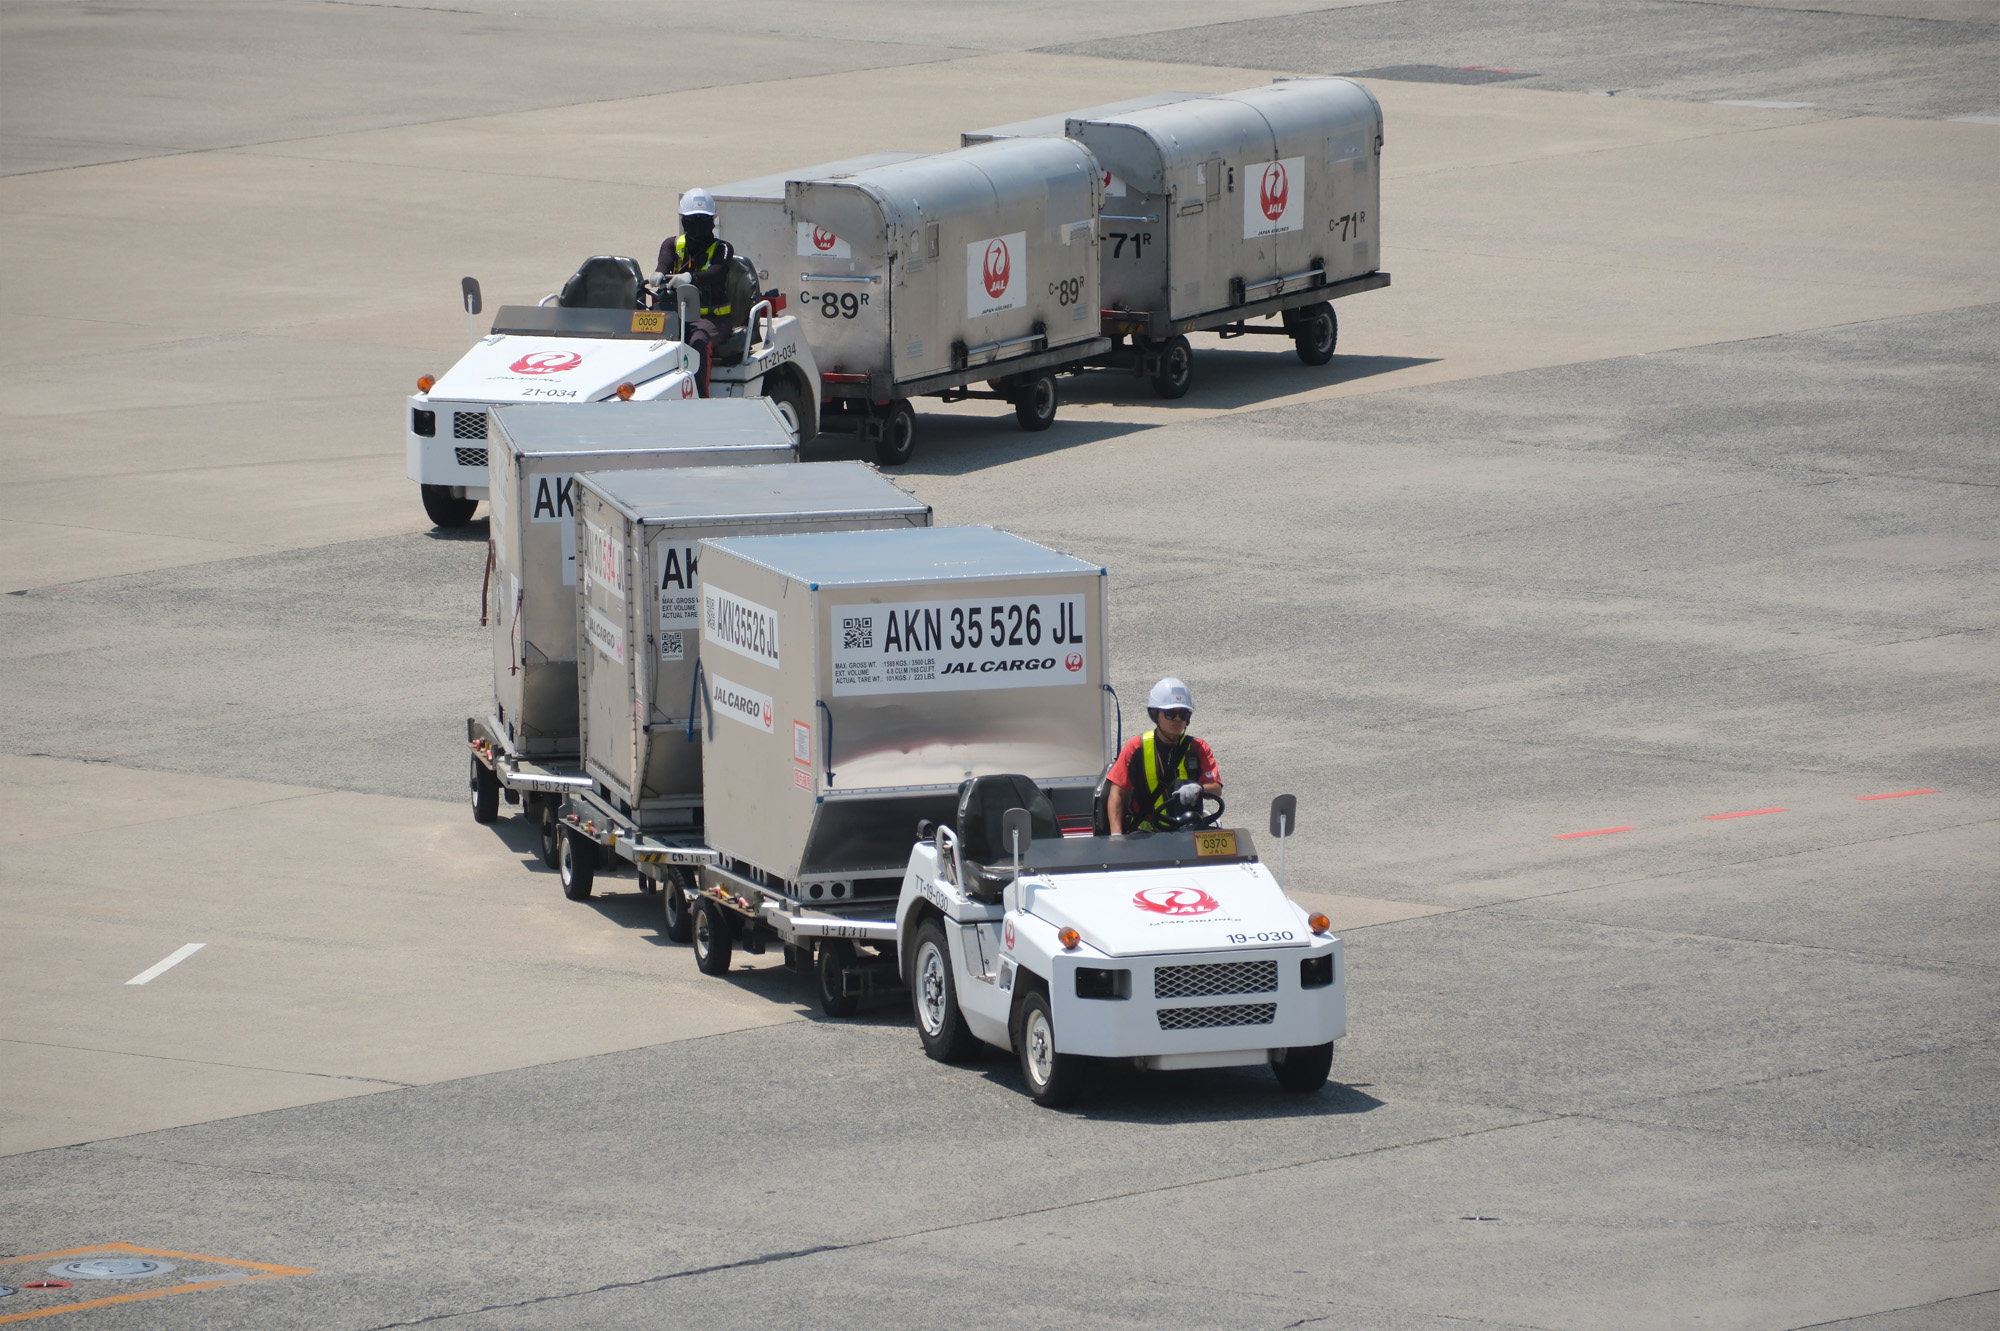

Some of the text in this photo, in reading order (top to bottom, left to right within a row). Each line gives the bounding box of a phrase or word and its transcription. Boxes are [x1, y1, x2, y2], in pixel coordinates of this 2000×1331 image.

[1267, 203, 1283, 214] JAL
[1100, 232, 1152, 259] -71R
[990, 280, 1006, 292] JAL
[638, 317, 658, 326] 0009
[758, 343, 797, 372] TT-21-034
[521, 388, 577, 398] 21-034
[533, 477, 574, 518] AK
[884, 608, 942, 653] AKN
[1052, 601, 1084, 645] JL
[848, 661, 867, 669] GROSS
[1203, 838, 1228, 849] 0370
[915, 874, 949, 912] TT-19-030
[1166, 905, 1211, 914] JAL
[1226, 930, 1294, 944] 19-030
